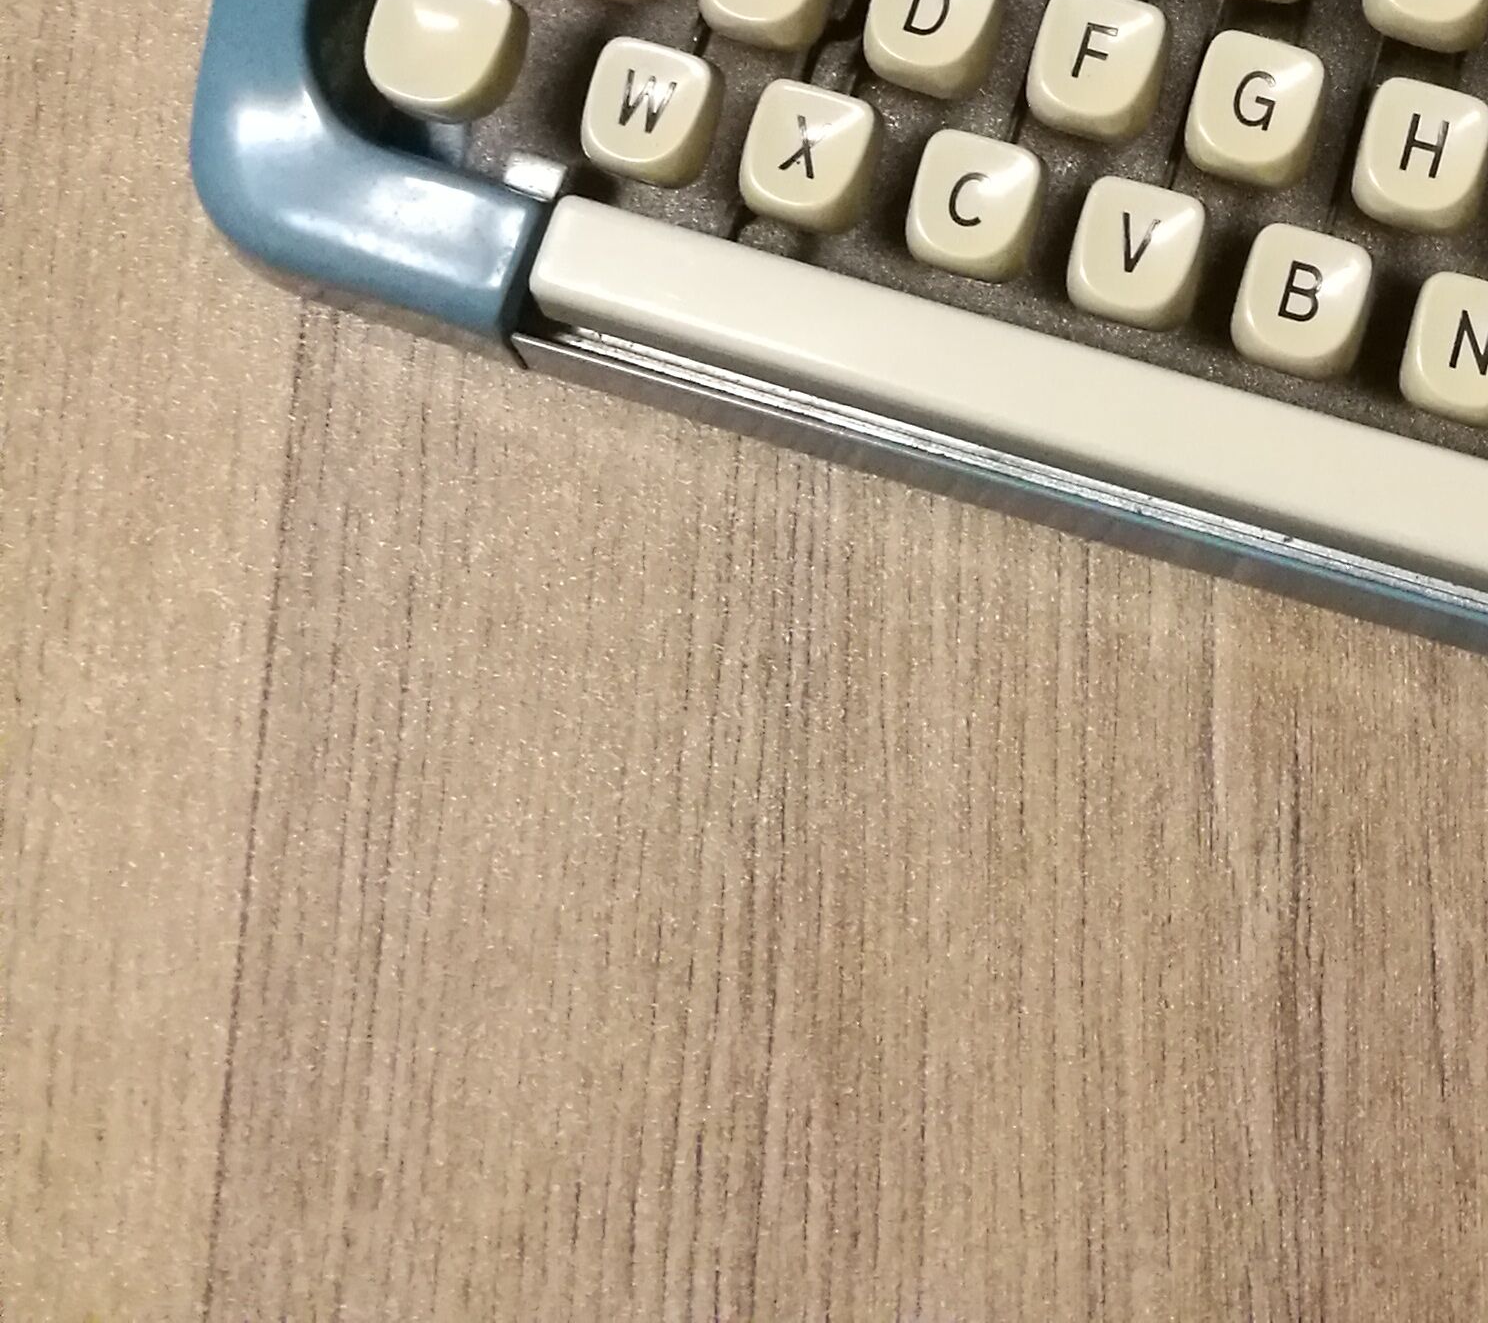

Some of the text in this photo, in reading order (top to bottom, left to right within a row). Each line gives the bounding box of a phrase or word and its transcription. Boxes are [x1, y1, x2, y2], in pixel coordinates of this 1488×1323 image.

[1070, 21, 1119, 79] F
[617, 68, 678, 135] W
[1232, 70, 1278, 133] G
[777, 115, 836, 180] X
[1398, 112, 1450, 179] H
[948, 171, 991, 228] C
[1121, 211, 1161, 274] V
[1276, 259, 1325, 323] B
